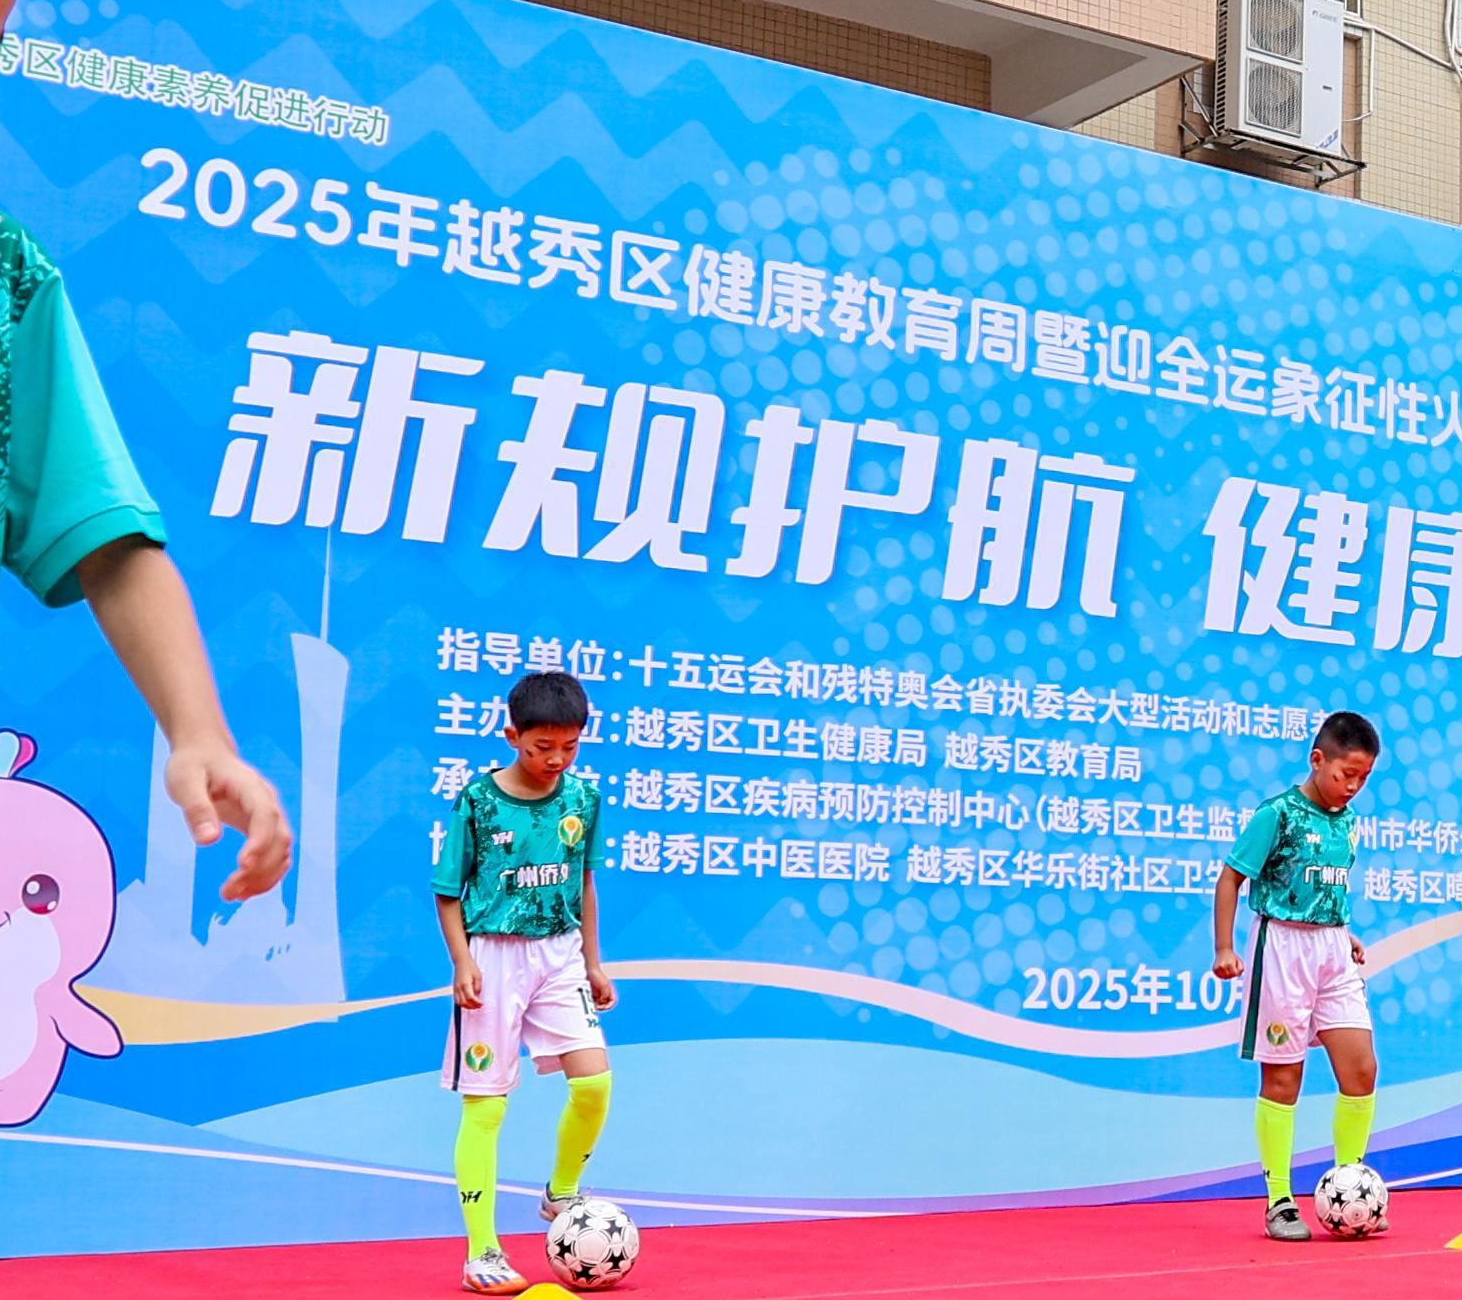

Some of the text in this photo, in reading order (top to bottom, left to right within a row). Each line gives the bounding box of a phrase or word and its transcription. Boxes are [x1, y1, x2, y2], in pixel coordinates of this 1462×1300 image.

[209, 329, 1136, 619] 新规护航
[944, 731, 1143, 783] 越秀区教育局
